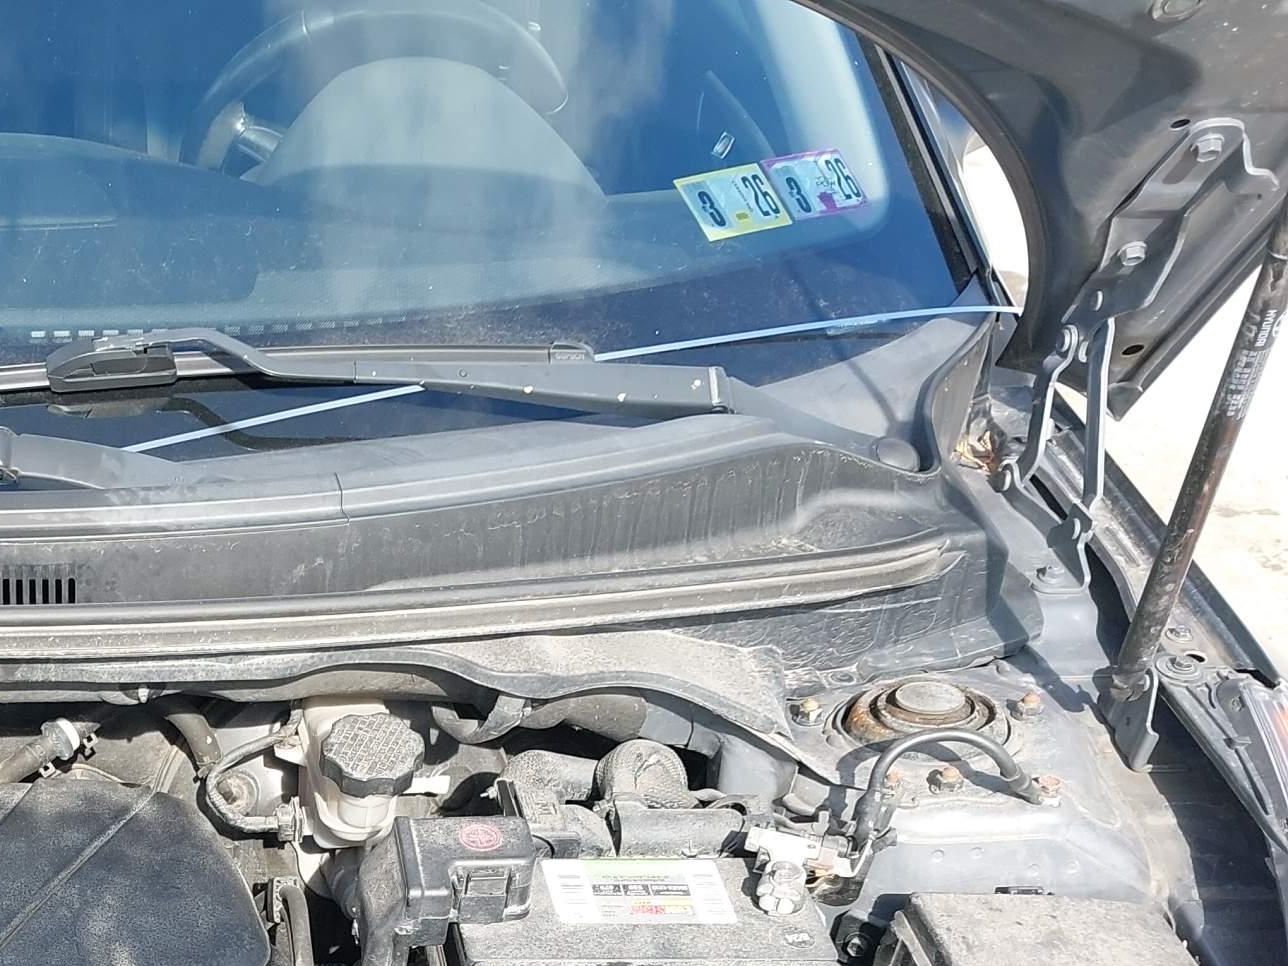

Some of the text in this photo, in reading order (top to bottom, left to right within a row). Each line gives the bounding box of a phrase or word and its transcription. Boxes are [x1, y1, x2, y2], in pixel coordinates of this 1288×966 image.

[698, 190, 727, 228] 3
[741, 174, 781, 217] 26
[786, 176, 812, 213] 3
[1254, 309, 1278, 347] HYUNDAI
